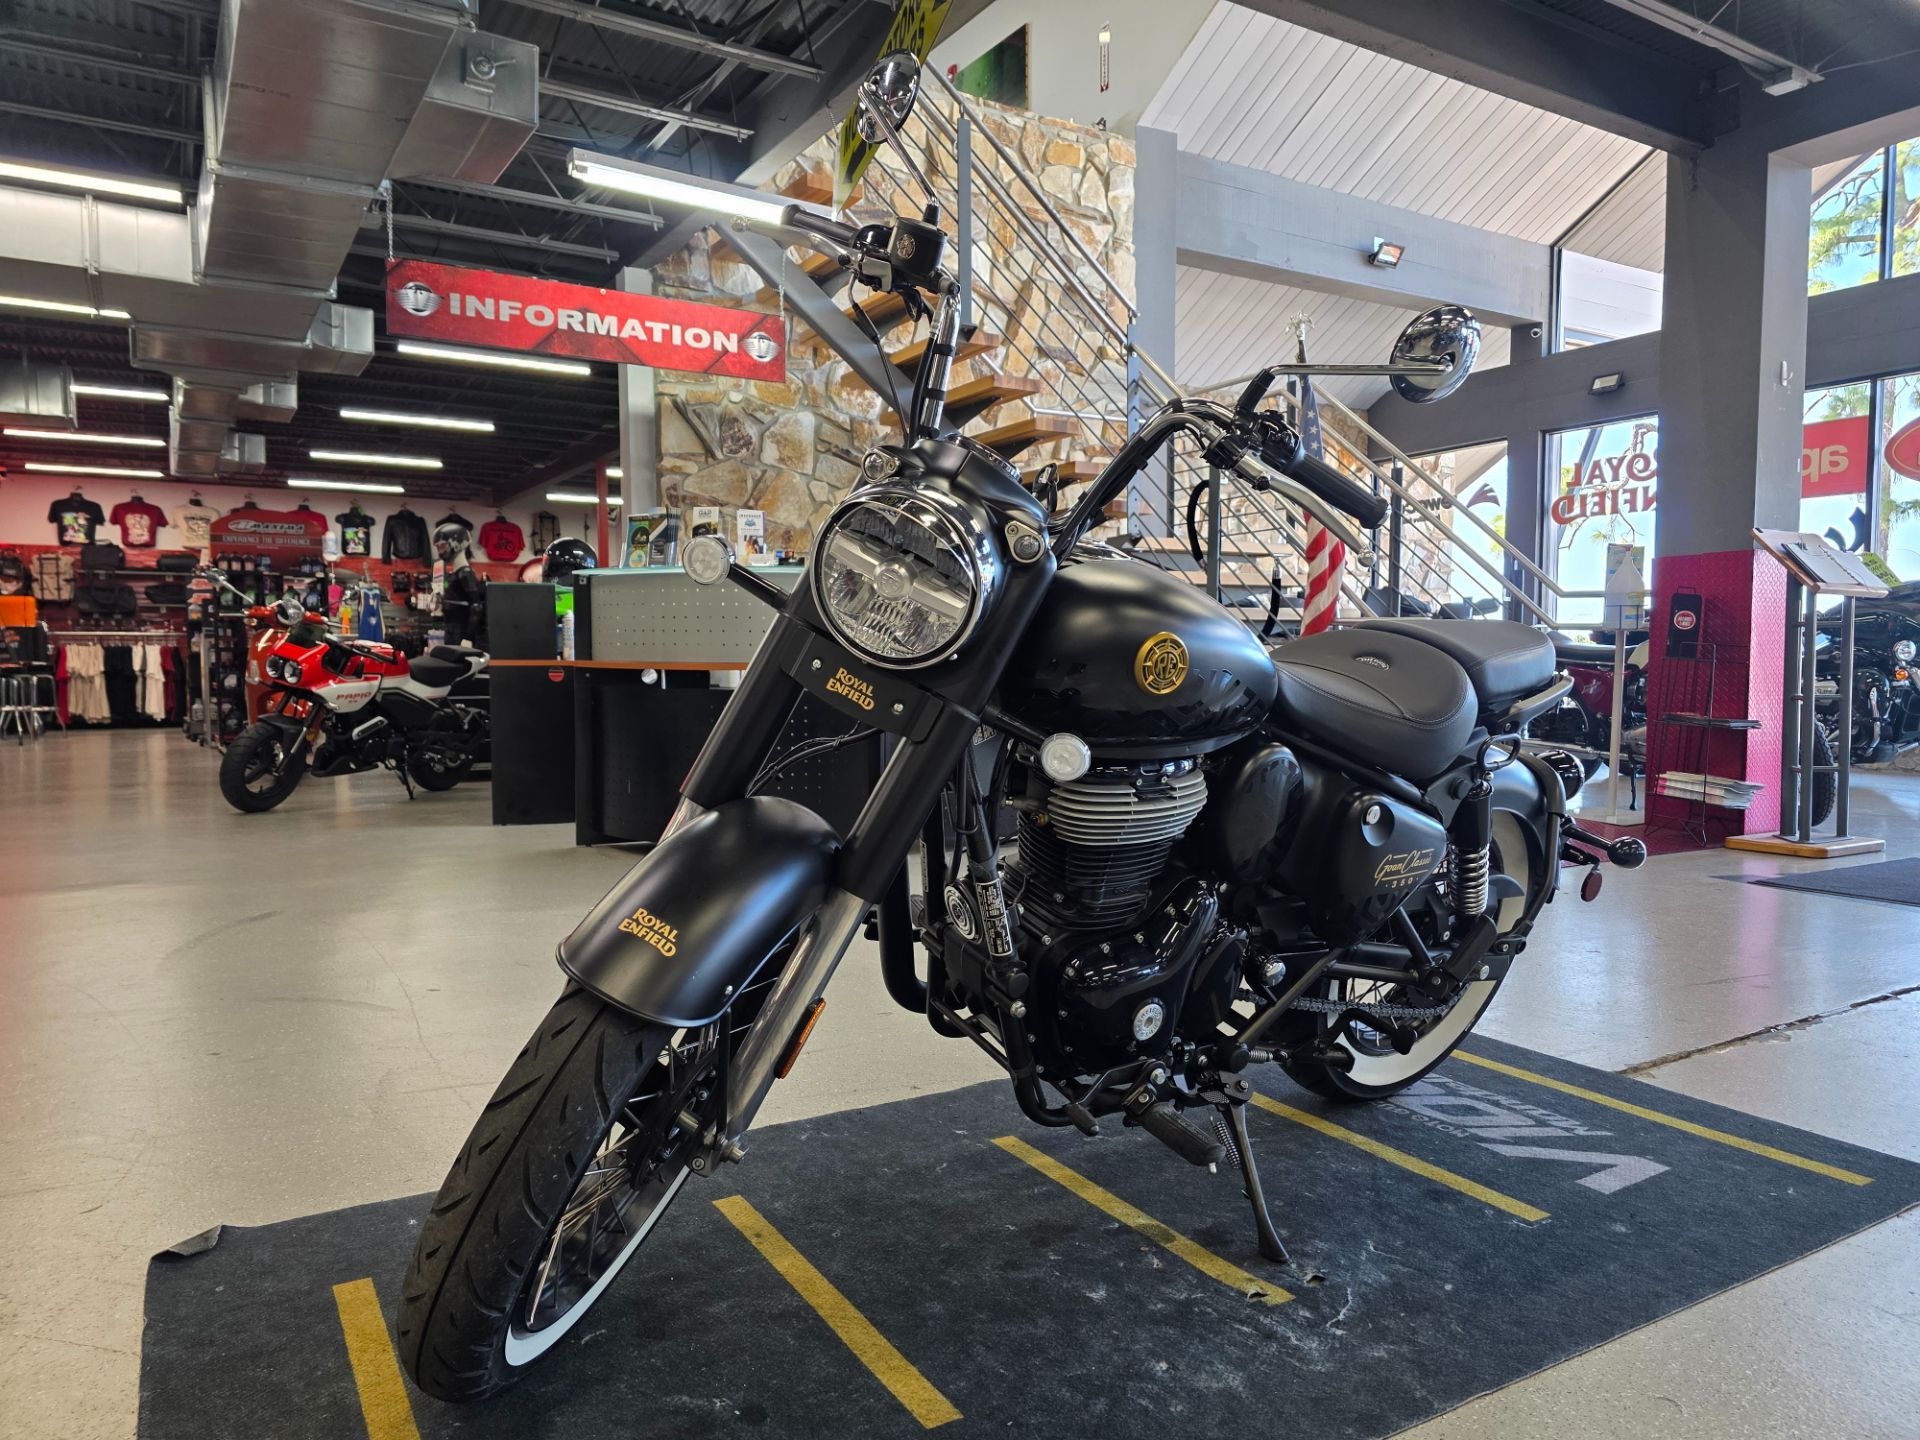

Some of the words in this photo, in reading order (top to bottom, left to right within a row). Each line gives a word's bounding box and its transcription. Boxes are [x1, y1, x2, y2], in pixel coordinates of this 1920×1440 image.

[449, 292, 739, 354] INFORMATION
[826, 677, 875, 711] ENFIELD
[835, 667, 874, 697] ROYAL
[1391, 877, 1414, 889] 350
[617, 918, 677, 957] ENFIELD
[632, 907, 678, 943] ROYAL
